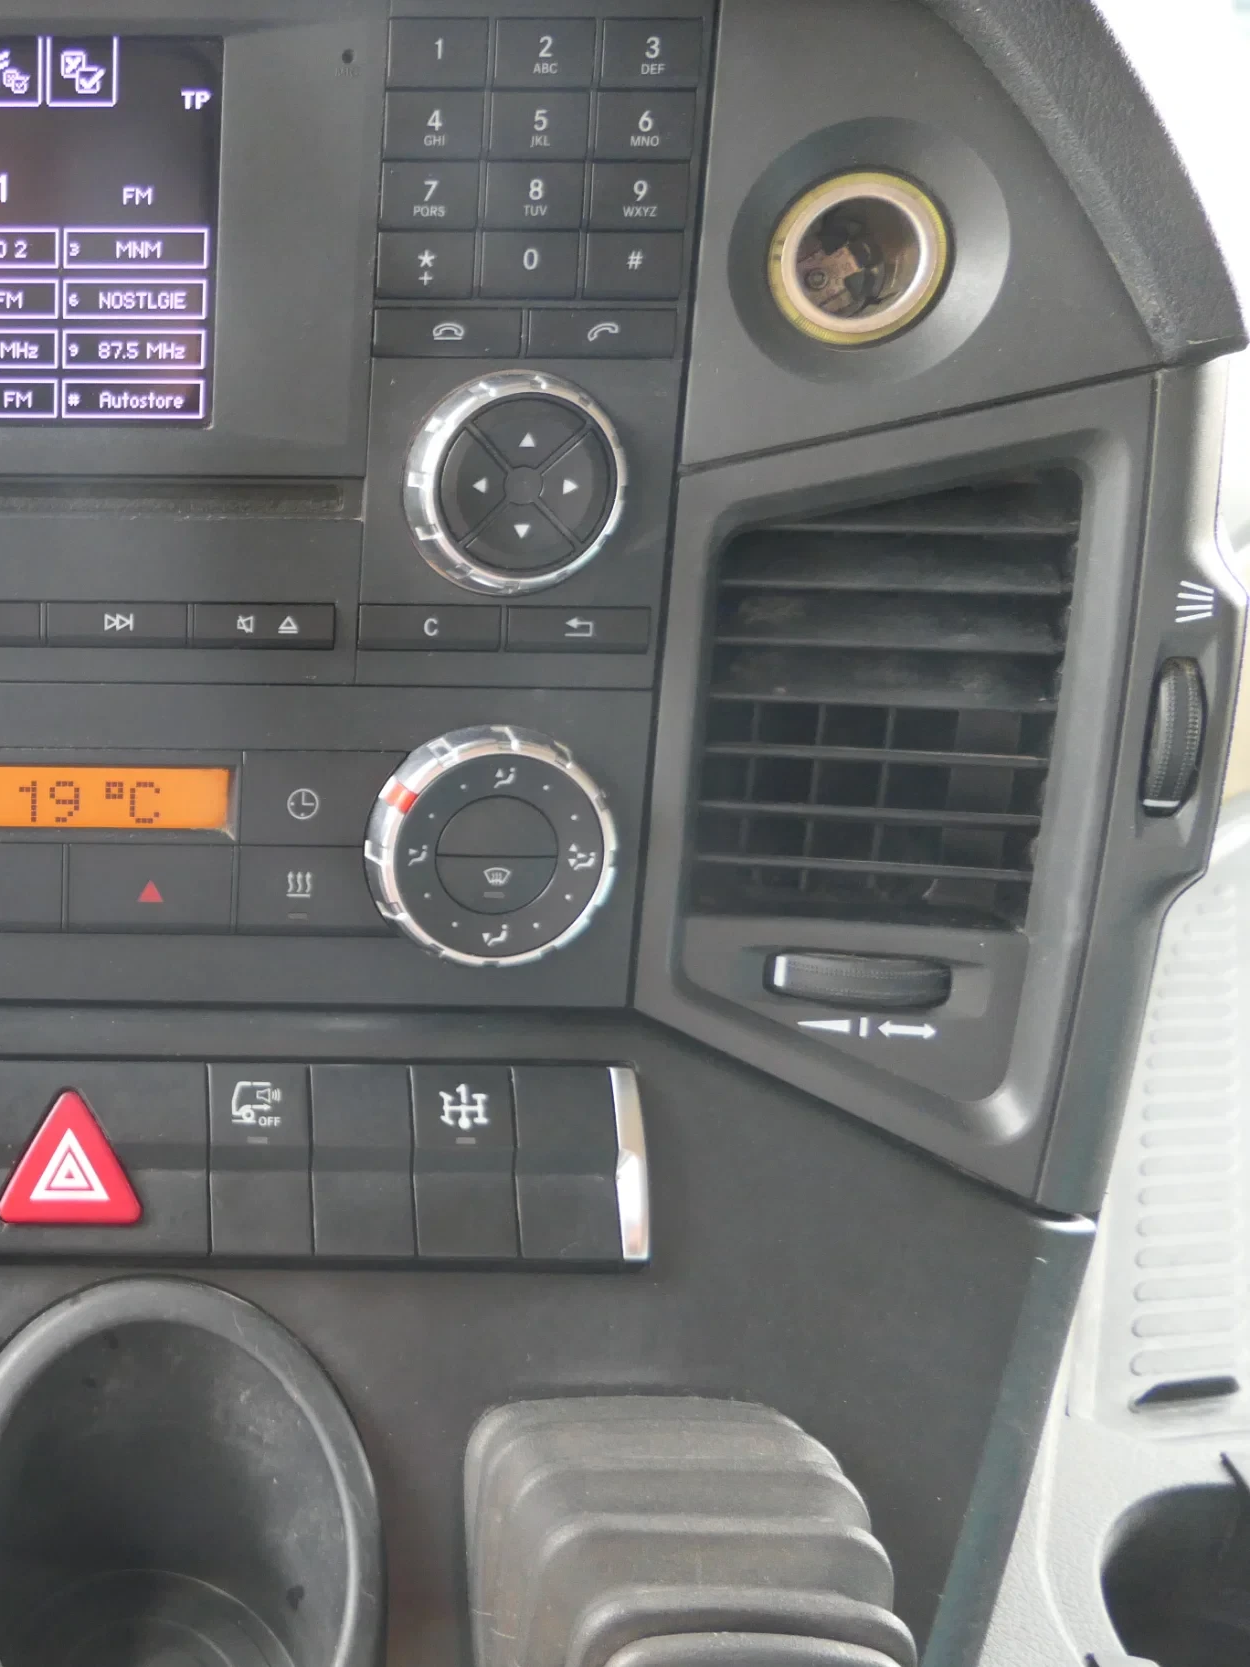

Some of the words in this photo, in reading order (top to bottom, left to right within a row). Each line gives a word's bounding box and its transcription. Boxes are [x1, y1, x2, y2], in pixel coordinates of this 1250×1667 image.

[434, 38, 444, 60] 1
[539, 36, 553, 58] 2
[645, 37, 660, 59] 3
[533, 63, 558, 75] ABC
[641, 64, 665, 75] DEF
[181, 90, 211, 110] TP
[427, 110, 442, 131] 4
[534, 110, 548, 131] 5
[639, 111, 653, 132] 6
[424, 135, 445, 146] GHI
[530, 135, 550, 147] JKL
[630, 135, 659, 147] MNO
[122, 187, 153, 205] FM
[424, 180, 440, 202] 7
[529, 179, 543, 200] 8
[633, 180, 648, 202] 9
[413, 206, 445, 218] PQRS
[524, 205, 548, 217] TUV
[623, 206, 657, 217] WXYZ
[14, 241, 28, 258] 2
[68, 243, 79, 257] 3
[115, 241, 162, 258] MNM
[523, 249, 538, 270] 0
[68, 294, 79, 307] 6
[98, 292, 187, 309] NOSTLGIE
[0, 342, 39, 359] MHz
[68, 344, 79, 357] 9
[98, 342, 139, 359] 87.5
[146, 342, 186, 359] MHz
[4, 391, 32, 409] FM
[99, 391, 184, 409] Autostore
[423, 617, 439, 637] C
[18, 780, 81, 825] 19
[258, 1115, 281, 1127] OFF
